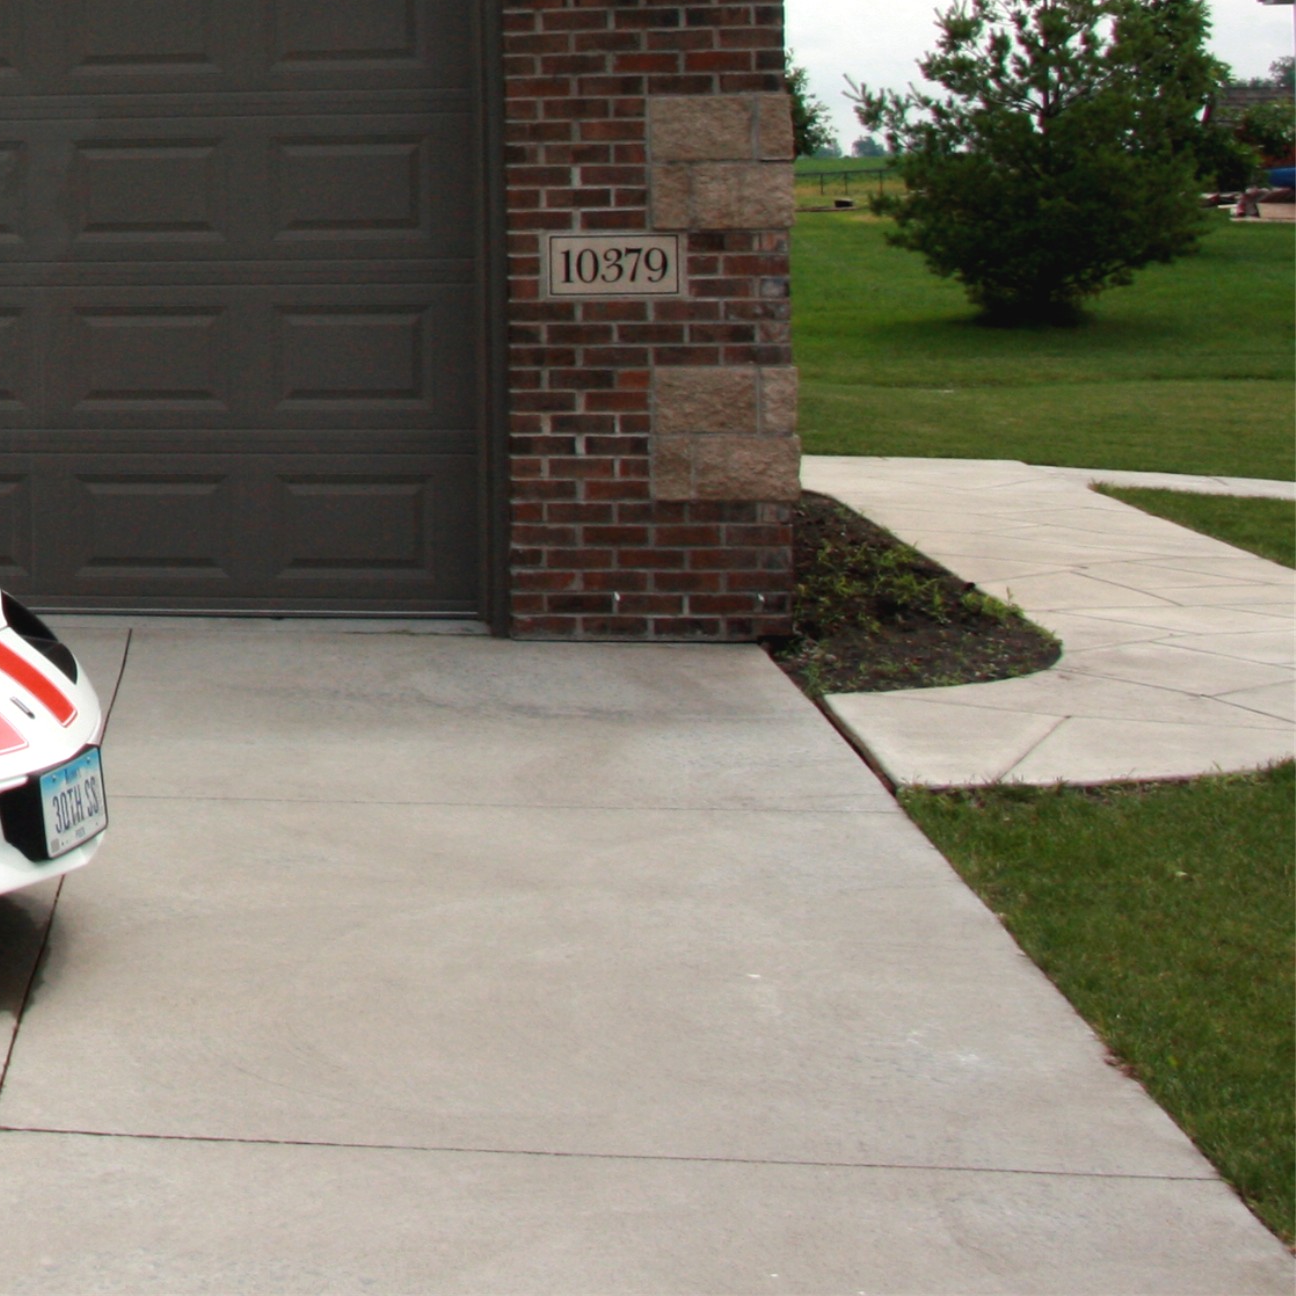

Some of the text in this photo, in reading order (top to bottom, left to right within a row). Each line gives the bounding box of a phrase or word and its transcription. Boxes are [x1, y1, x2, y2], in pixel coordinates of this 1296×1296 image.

[561, 247, 669, 284] 10379
[52, 775, 100, 835] 30TH SS
